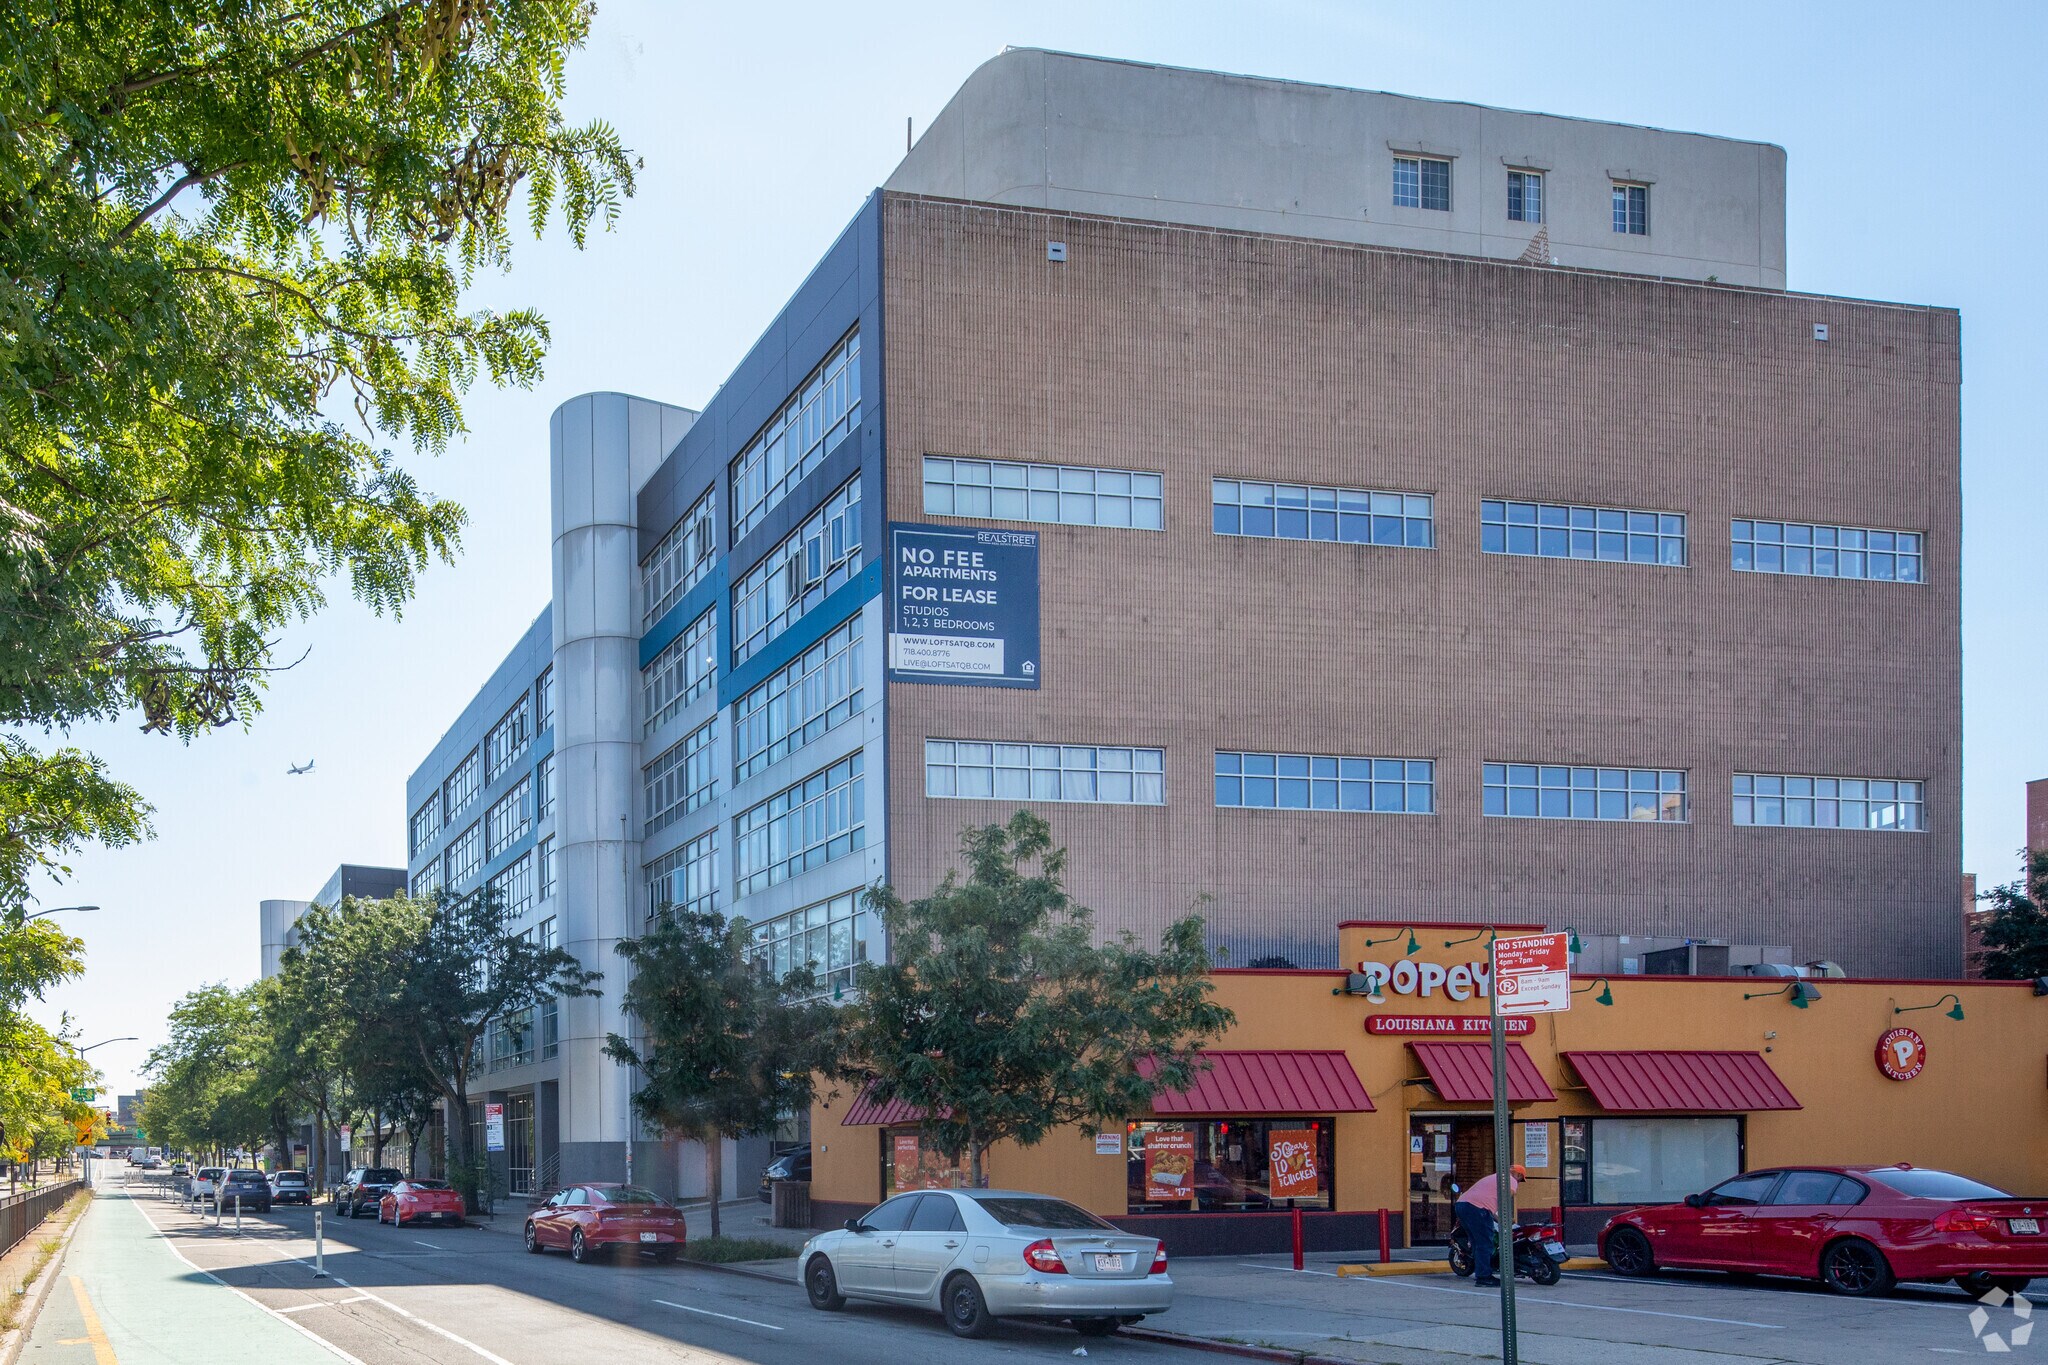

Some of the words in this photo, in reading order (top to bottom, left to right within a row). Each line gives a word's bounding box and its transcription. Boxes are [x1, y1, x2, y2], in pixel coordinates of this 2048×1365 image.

[978, 533, 1036, 545] REALSTREET
[902, 547, 935, 564] NO
[943, 550, 984, 568] FEE
[903, 565, 997, 581] APARTMENTS
[902, 585, 938, 601] FOR
[942, 587, 997, 604] LEASE
[903, 605, 949, 616] STUDIOS
[922, 618, 929, 627] 3
[934, 619, 995, 631] BEDROOMS
[903, 637, 995, 648] WWW.LOFTSATQB.COM
[903, 648, 951, 657] 718.400.8776
[903, 659, 991, 670] LIVE@LOFTSATQB.COM
[1498, 942, 1510, 950] NO
[1512, 938, 1555, 949] STANDING
[1498, 951, 1523, 959] Monday
[1529, 948, 1550, 956] Friday
[1360, 959, 1490, 1001] POPEY
[1375, 1018, 1456, 1031] LOUISIANA
[1463, 1018, 1528, 1031] KITEN
[1882, 1028, 1924, 1051] LOUISIANA
[1893, 1040, 1914, 1068] P
[1884, 1062, 1922, 1080] KITCHEN
[1413, 1138, 1421, 1148] A
[1270, 1141, 1293, 1161] 50
[1283, 1166, 1317, 1187] CHICKEN
